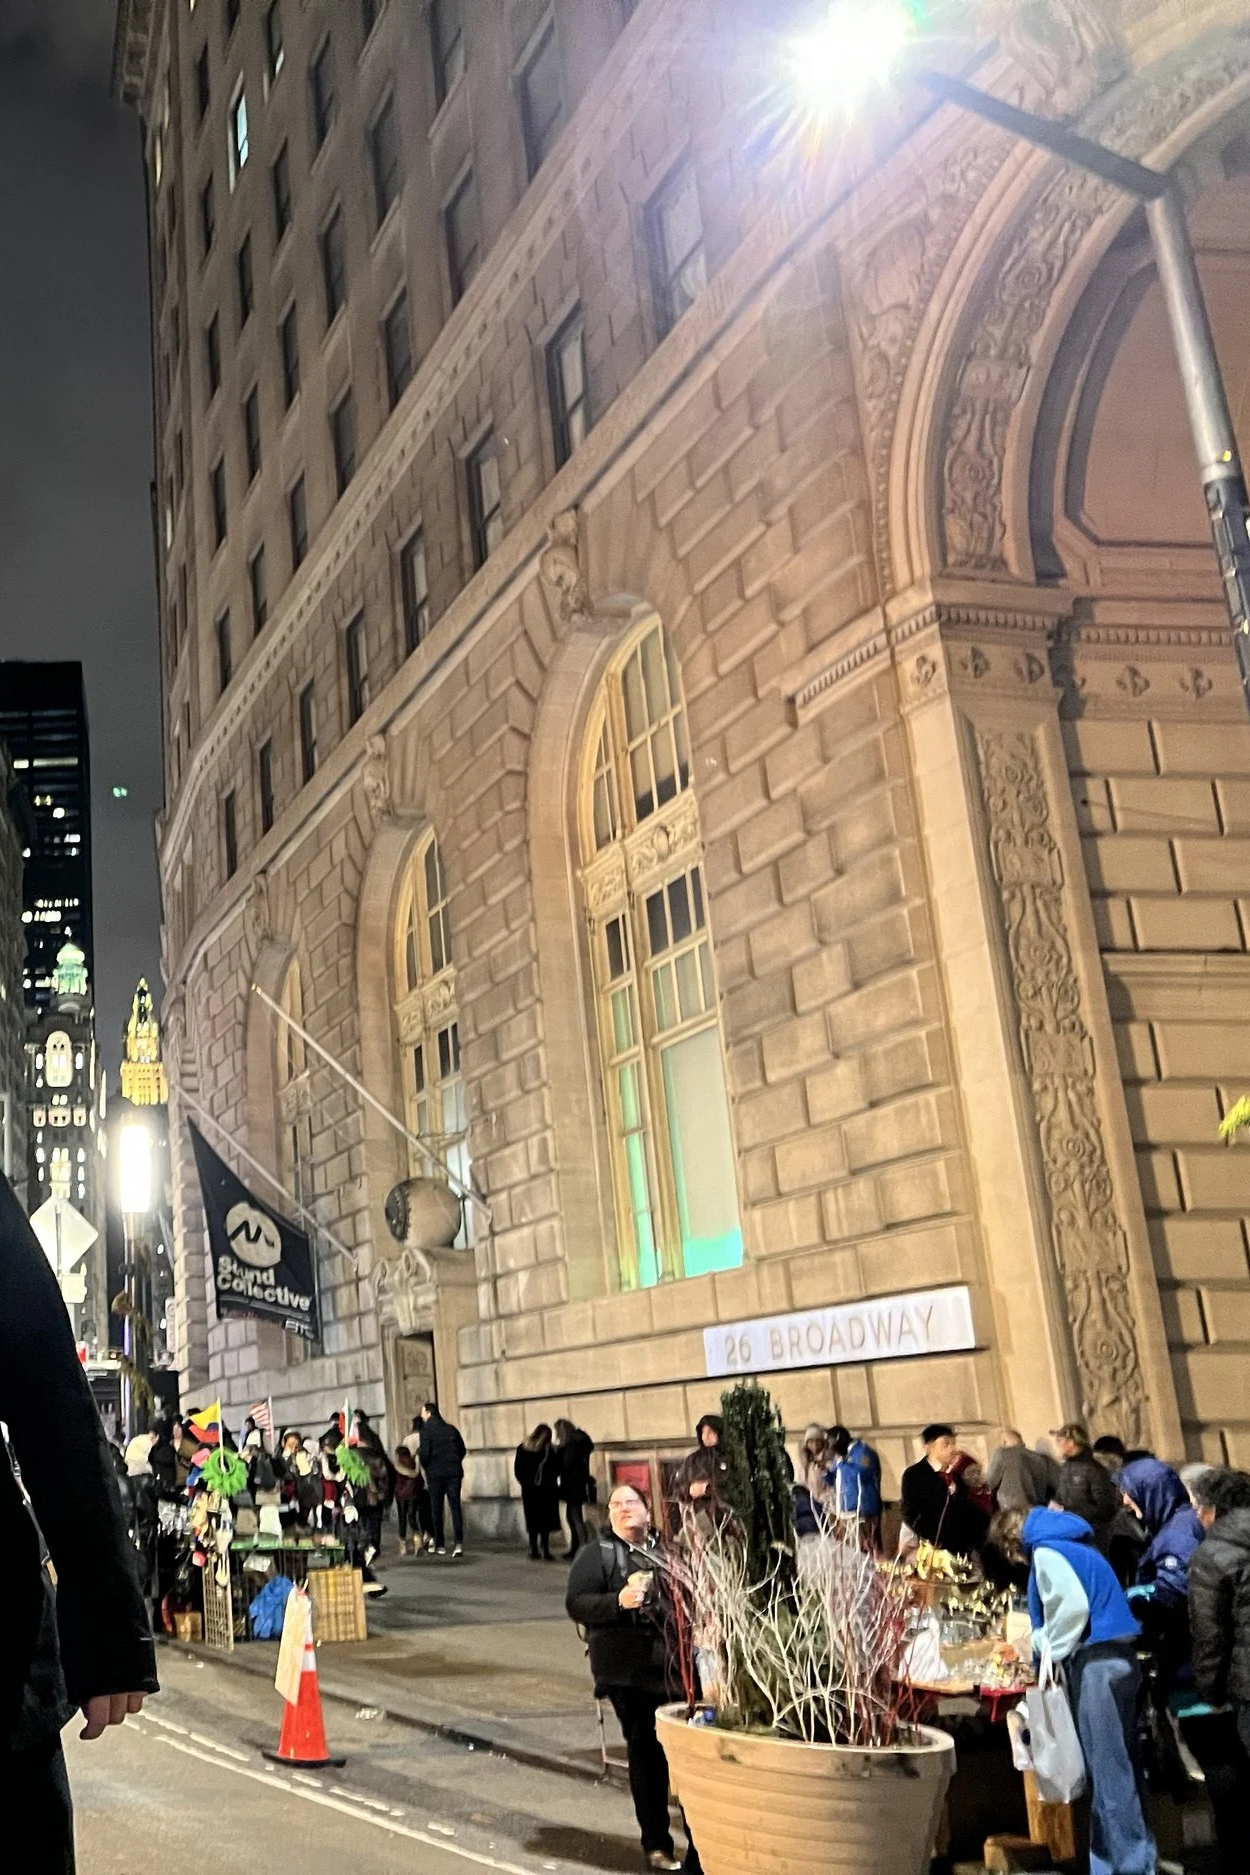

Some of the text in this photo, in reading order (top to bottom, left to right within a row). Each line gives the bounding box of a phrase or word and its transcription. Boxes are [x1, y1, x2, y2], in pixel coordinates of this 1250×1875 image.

[217, 1272, 310, 1312] Collective
[724, 1305, 934, 1366] 26 BROADWAY
